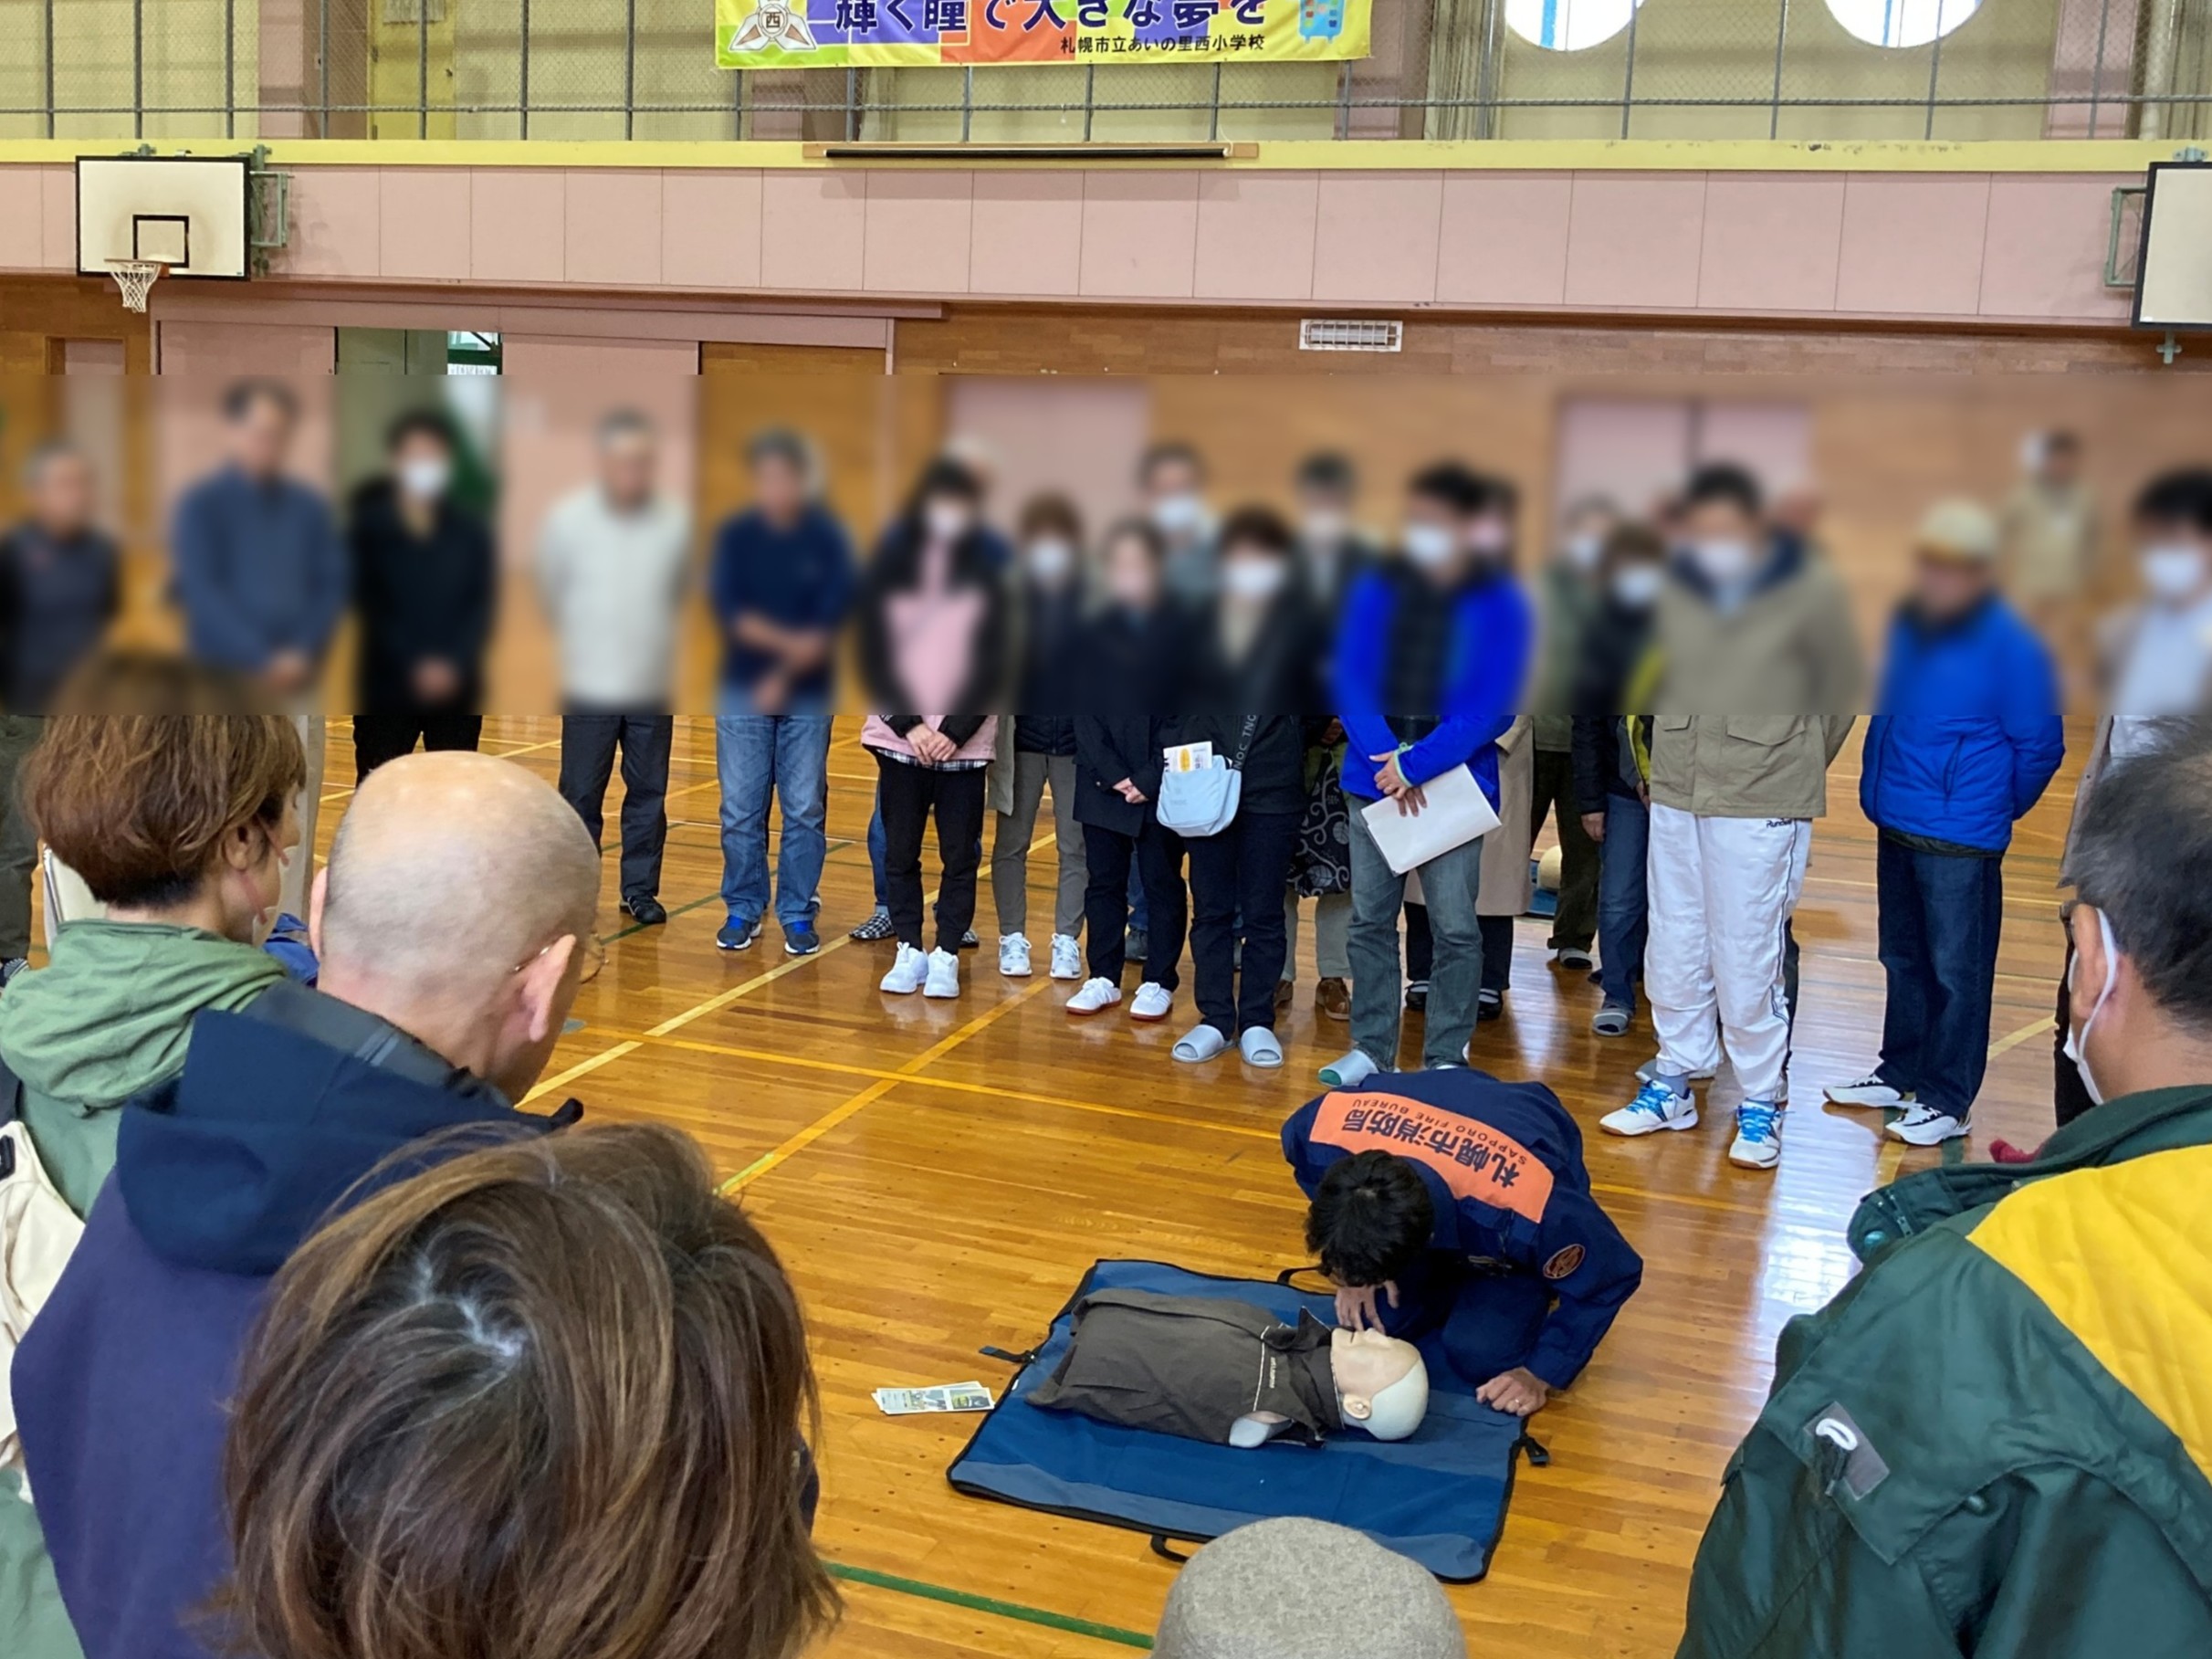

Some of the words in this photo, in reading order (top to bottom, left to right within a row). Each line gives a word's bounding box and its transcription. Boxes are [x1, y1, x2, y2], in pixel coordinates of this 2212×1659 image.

[765, 12, 781, 27] 西
[1061, 34, 1265, 53] 札幌市立あいの里西小学校
[1352, 1098, 1410, 1115] BUREAU
[1415, 1111, 1450, 1129] FIRE
[1341, 1108, 1520, 1188] 札幌市消防局
[1455, 1125, 1527, 1165] SAPPORO
